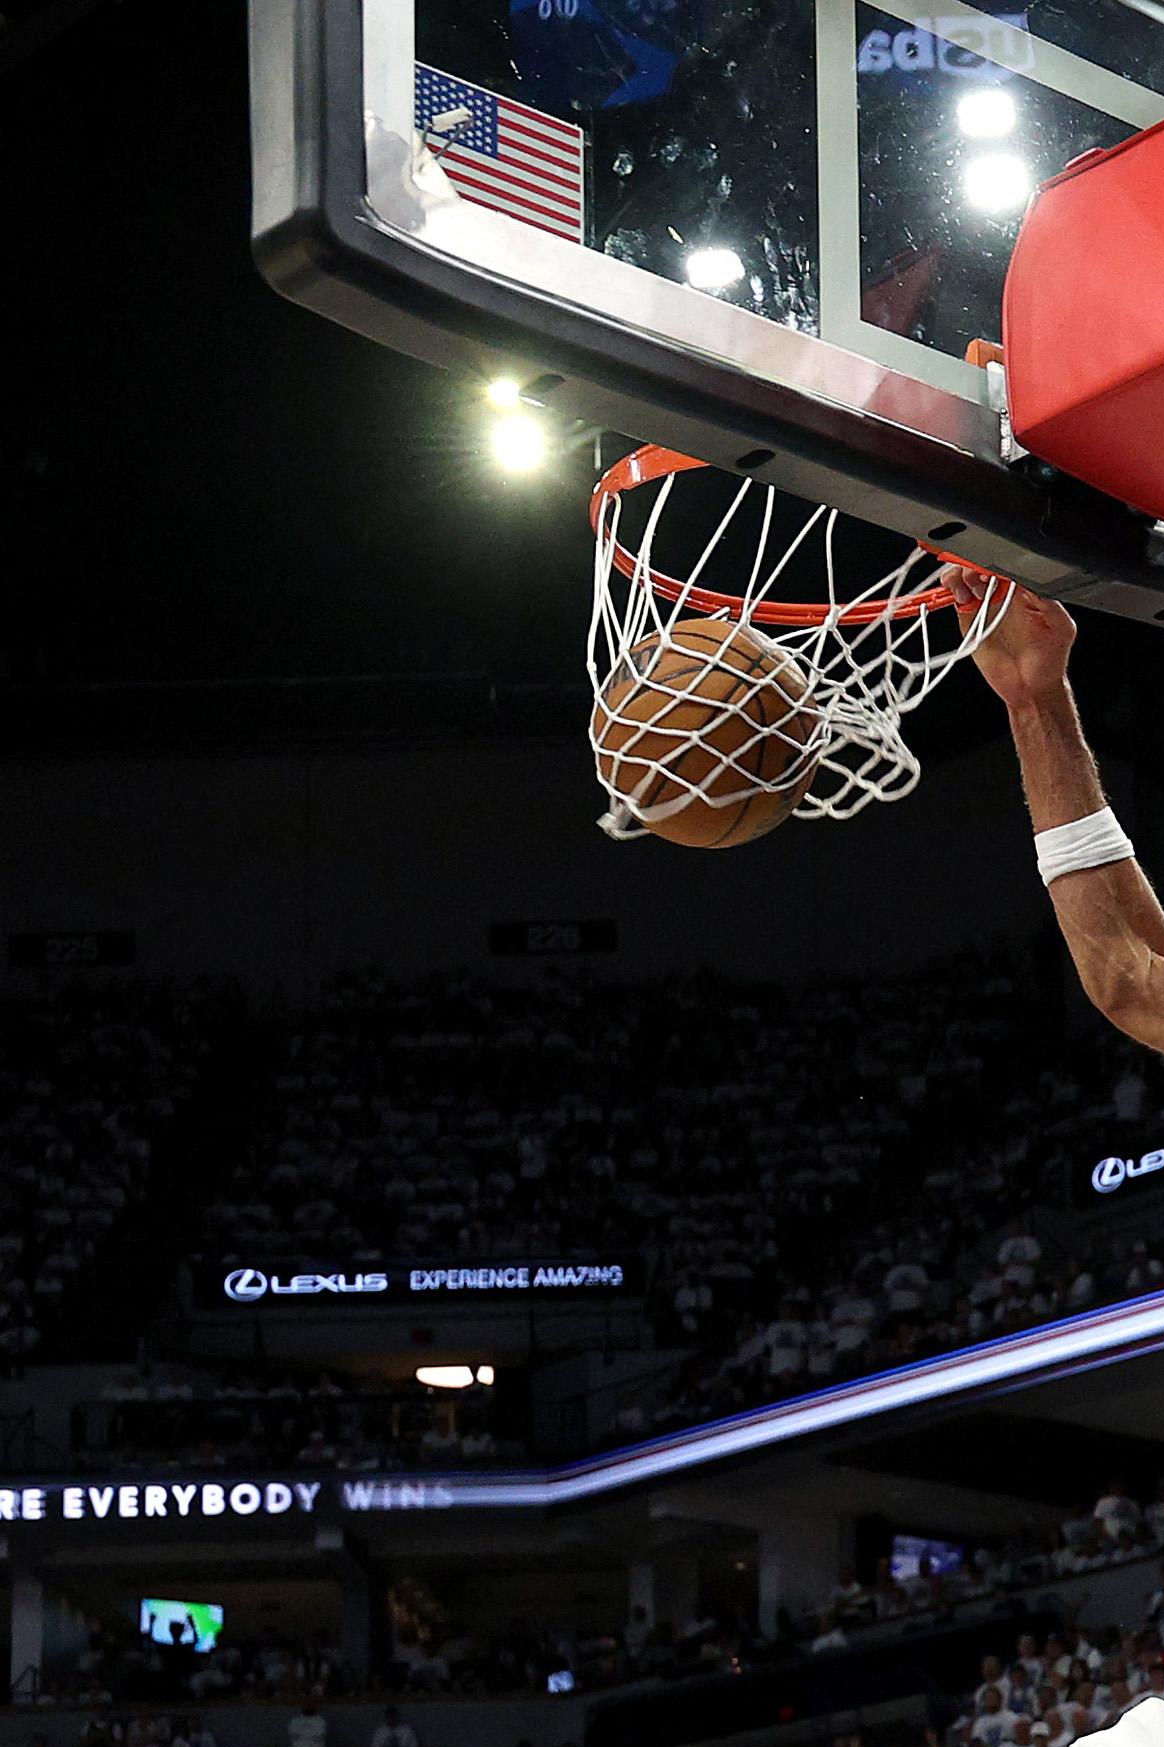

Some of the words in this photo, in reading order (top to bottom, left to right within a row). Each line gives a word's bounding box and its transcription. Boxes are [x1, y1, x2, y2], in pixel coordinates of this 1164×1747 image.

[271, 1273, 388, 1294] LEXUS
[410, 1269, 530, 1290] EXPERIENCE
[533, 1265, 623, 1288] AMAZING
[63, 1483, 321, 1519] EVERYBODY
